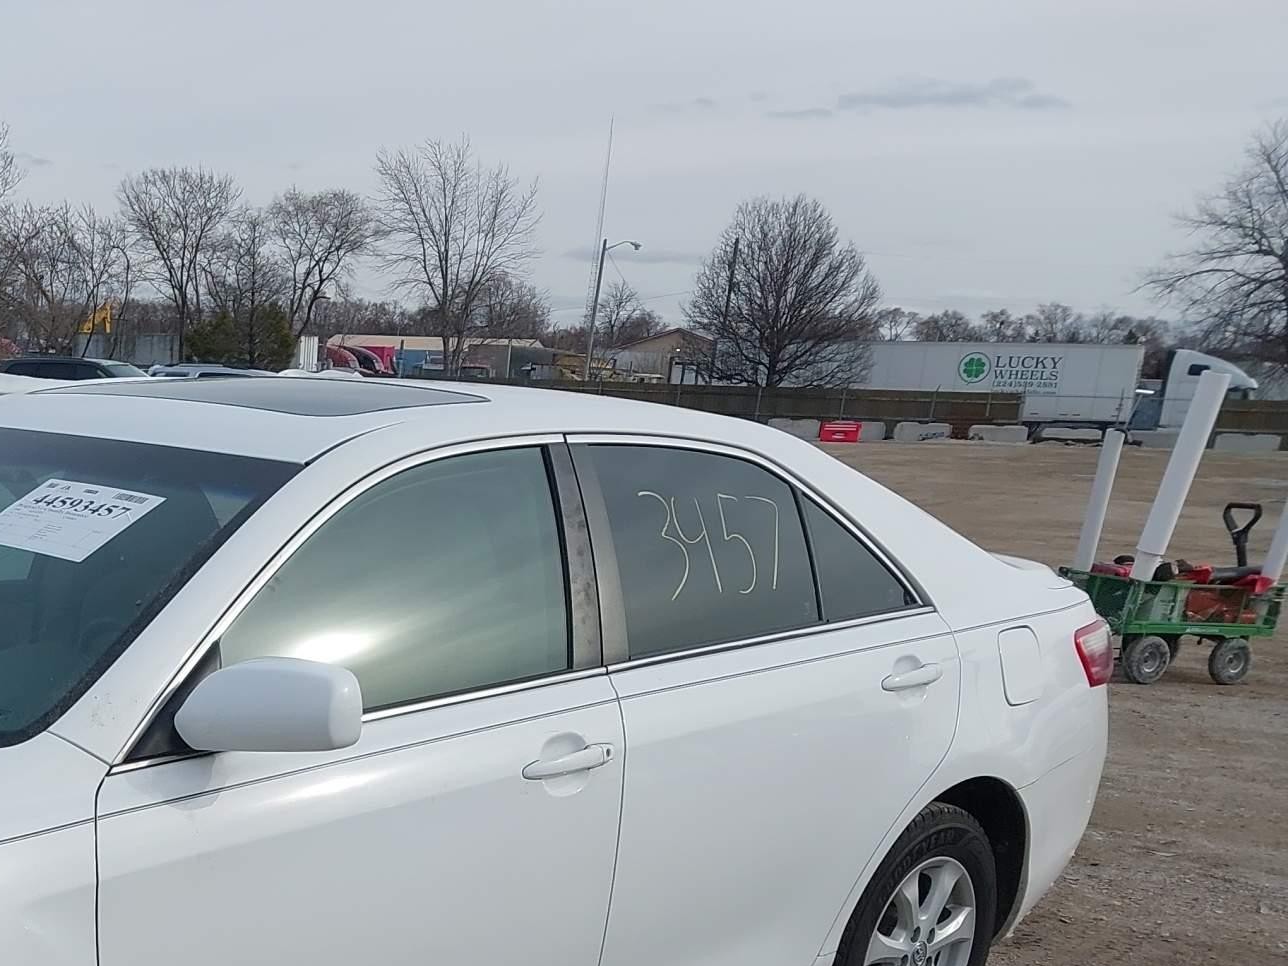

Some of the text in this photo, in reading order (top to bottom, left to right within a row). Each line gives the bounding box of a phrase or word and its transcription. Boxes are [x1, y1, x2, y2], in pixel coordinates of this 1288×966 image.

[995, 356, 1063, 369] LUCKY
[994, 369, 1059, 381] WHEELS
[32, 493, 133, 520] 44593457
[637, 491, 779, 601] 3457
